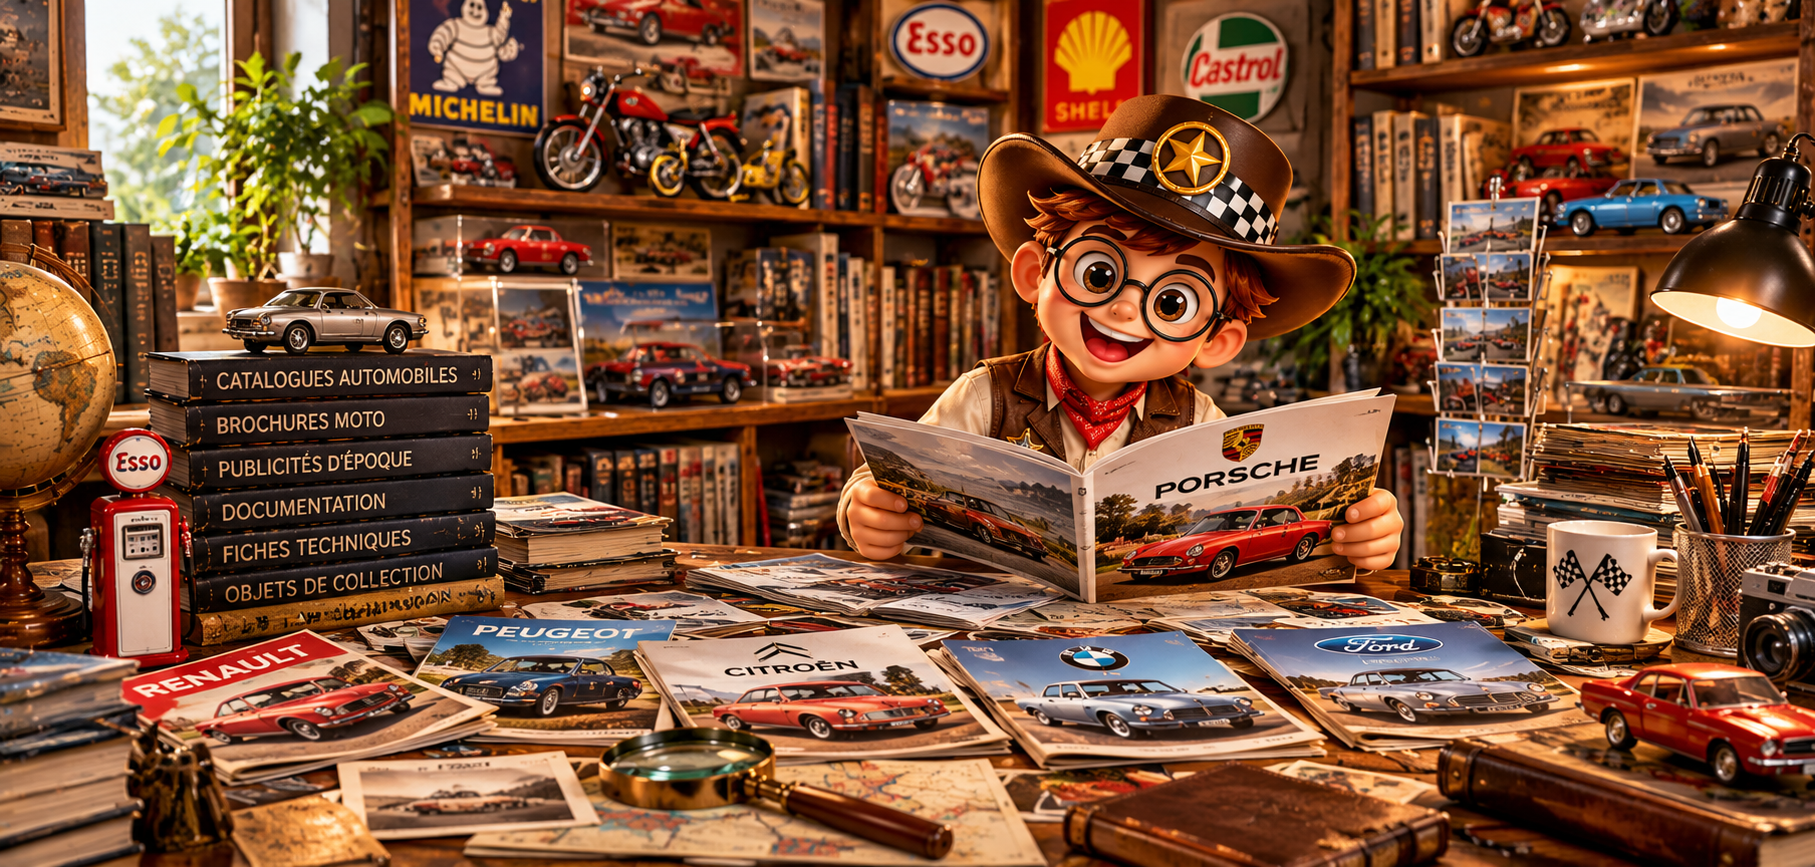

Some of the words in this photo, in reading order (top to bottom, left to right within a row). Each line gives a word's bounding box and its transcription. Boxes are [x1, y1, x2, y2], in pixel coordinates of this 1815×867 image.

[906, 21, 976, 57] Esso
[1190, 46, 1284, 88] Castrol
[409, 92, 539, 127] MICHELIN
[1055, 99, 1124, 123] SHEL
[216, 370, 334, 391] CATALOGUES
[339, 366, 458, 387] AUTOMOBILES
[216, 412, 329, 435] BROCHURES
[335, 410, 385, 429] MOTO
[218, 450, 322, 478] PUBLICITÉS
[328, 448, 413, 472] D'ÉPOQUE
[1155, 453, 1321, 500] PORSCHE
[221, 492, 386, 522] DOCUMENTATION
[222, 540, 290, 564] FICHES
[296, 529, 412, 558] TECHNIQUES
[225, 580, 297, 603] OBJETS
[304, 576, 327, 596] DE
[333, 562, 444, 593] COLLECTION
[472, 624, 644, 639] PEUGEOT
[1343, 637, 1421, 653] Ford
[132, 643, 310, 698] RENAULT
[724, 658, 860, 678] CITROËN
